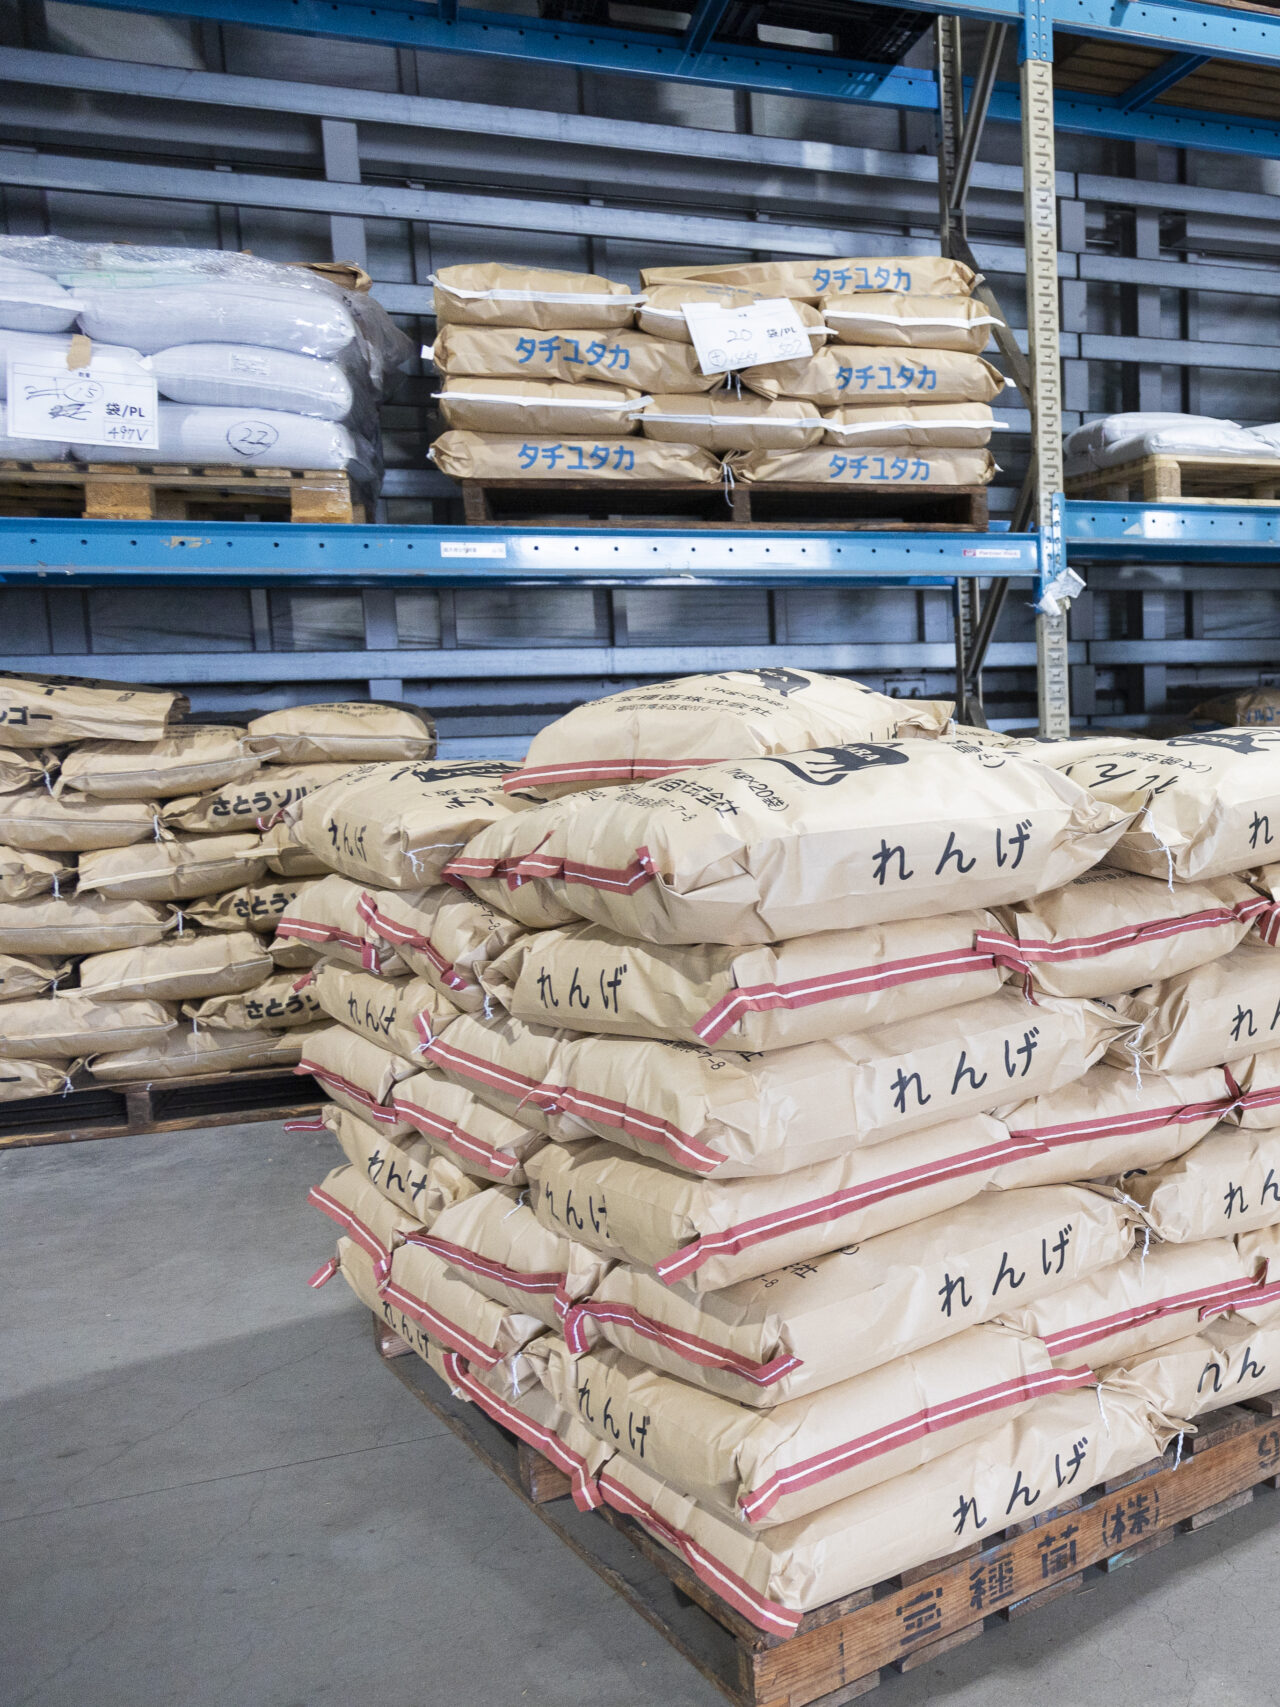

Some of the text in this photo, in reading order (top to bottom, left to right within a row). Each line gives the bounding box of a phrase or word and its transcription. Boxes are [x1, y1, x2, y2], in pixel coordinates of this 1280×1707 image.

[812, 267, 912, 292] タチユタカ
[515, 336, 630, 371] タチユタカ
[835, 365, 937, 391] タチユタカ
[105, 402, 146, 418] 袋/PL
[518, 443, 636, 472] タチユタカ
[828, 454, 931, 482] タチユタカ
[0, 705, 53, 726] ゴー
[872, 818, 1033, 885] れんげ
[234, 892, 297, 918] さとう
[537, 963, 627, 1014] れんげ
[889, 1025, 1041, 1114] れんげ
[938, 1223, 1074, 1318] れんげ
[952, 1436, 1090, 1537] れんげ
